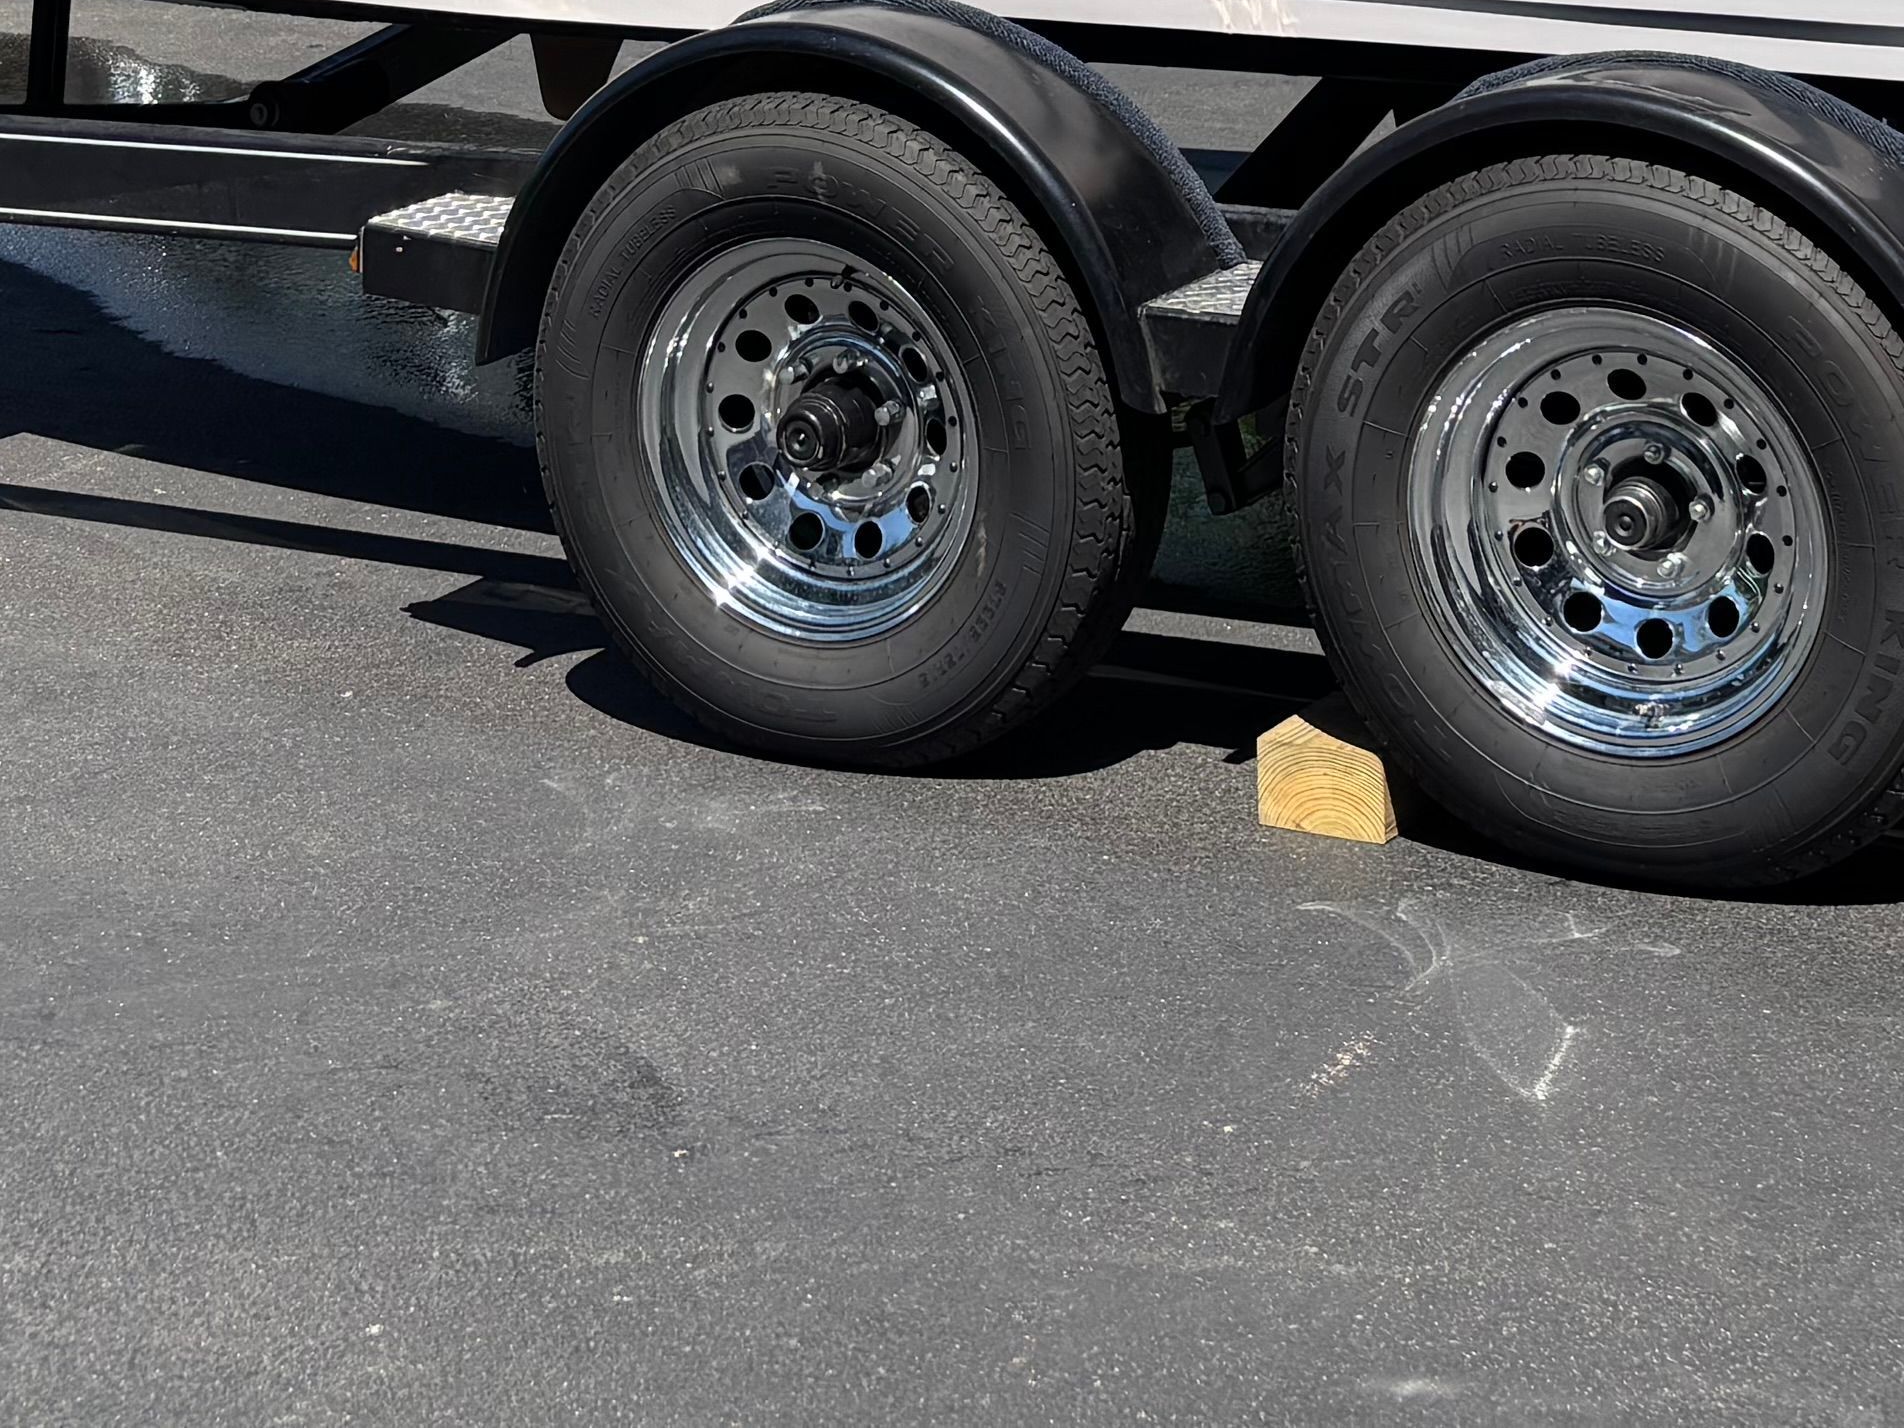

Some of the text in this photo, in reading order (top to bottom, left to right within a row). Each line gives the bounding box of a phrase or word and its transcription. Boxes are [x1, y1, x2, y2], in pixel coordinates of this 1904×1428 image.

[766, 166, 955, 273] POWER
[1500, 234, 1565, 261] RADIAL
[588, 265, 622, 319] RADIAL
[1337, 290, 1423, 417] STR
